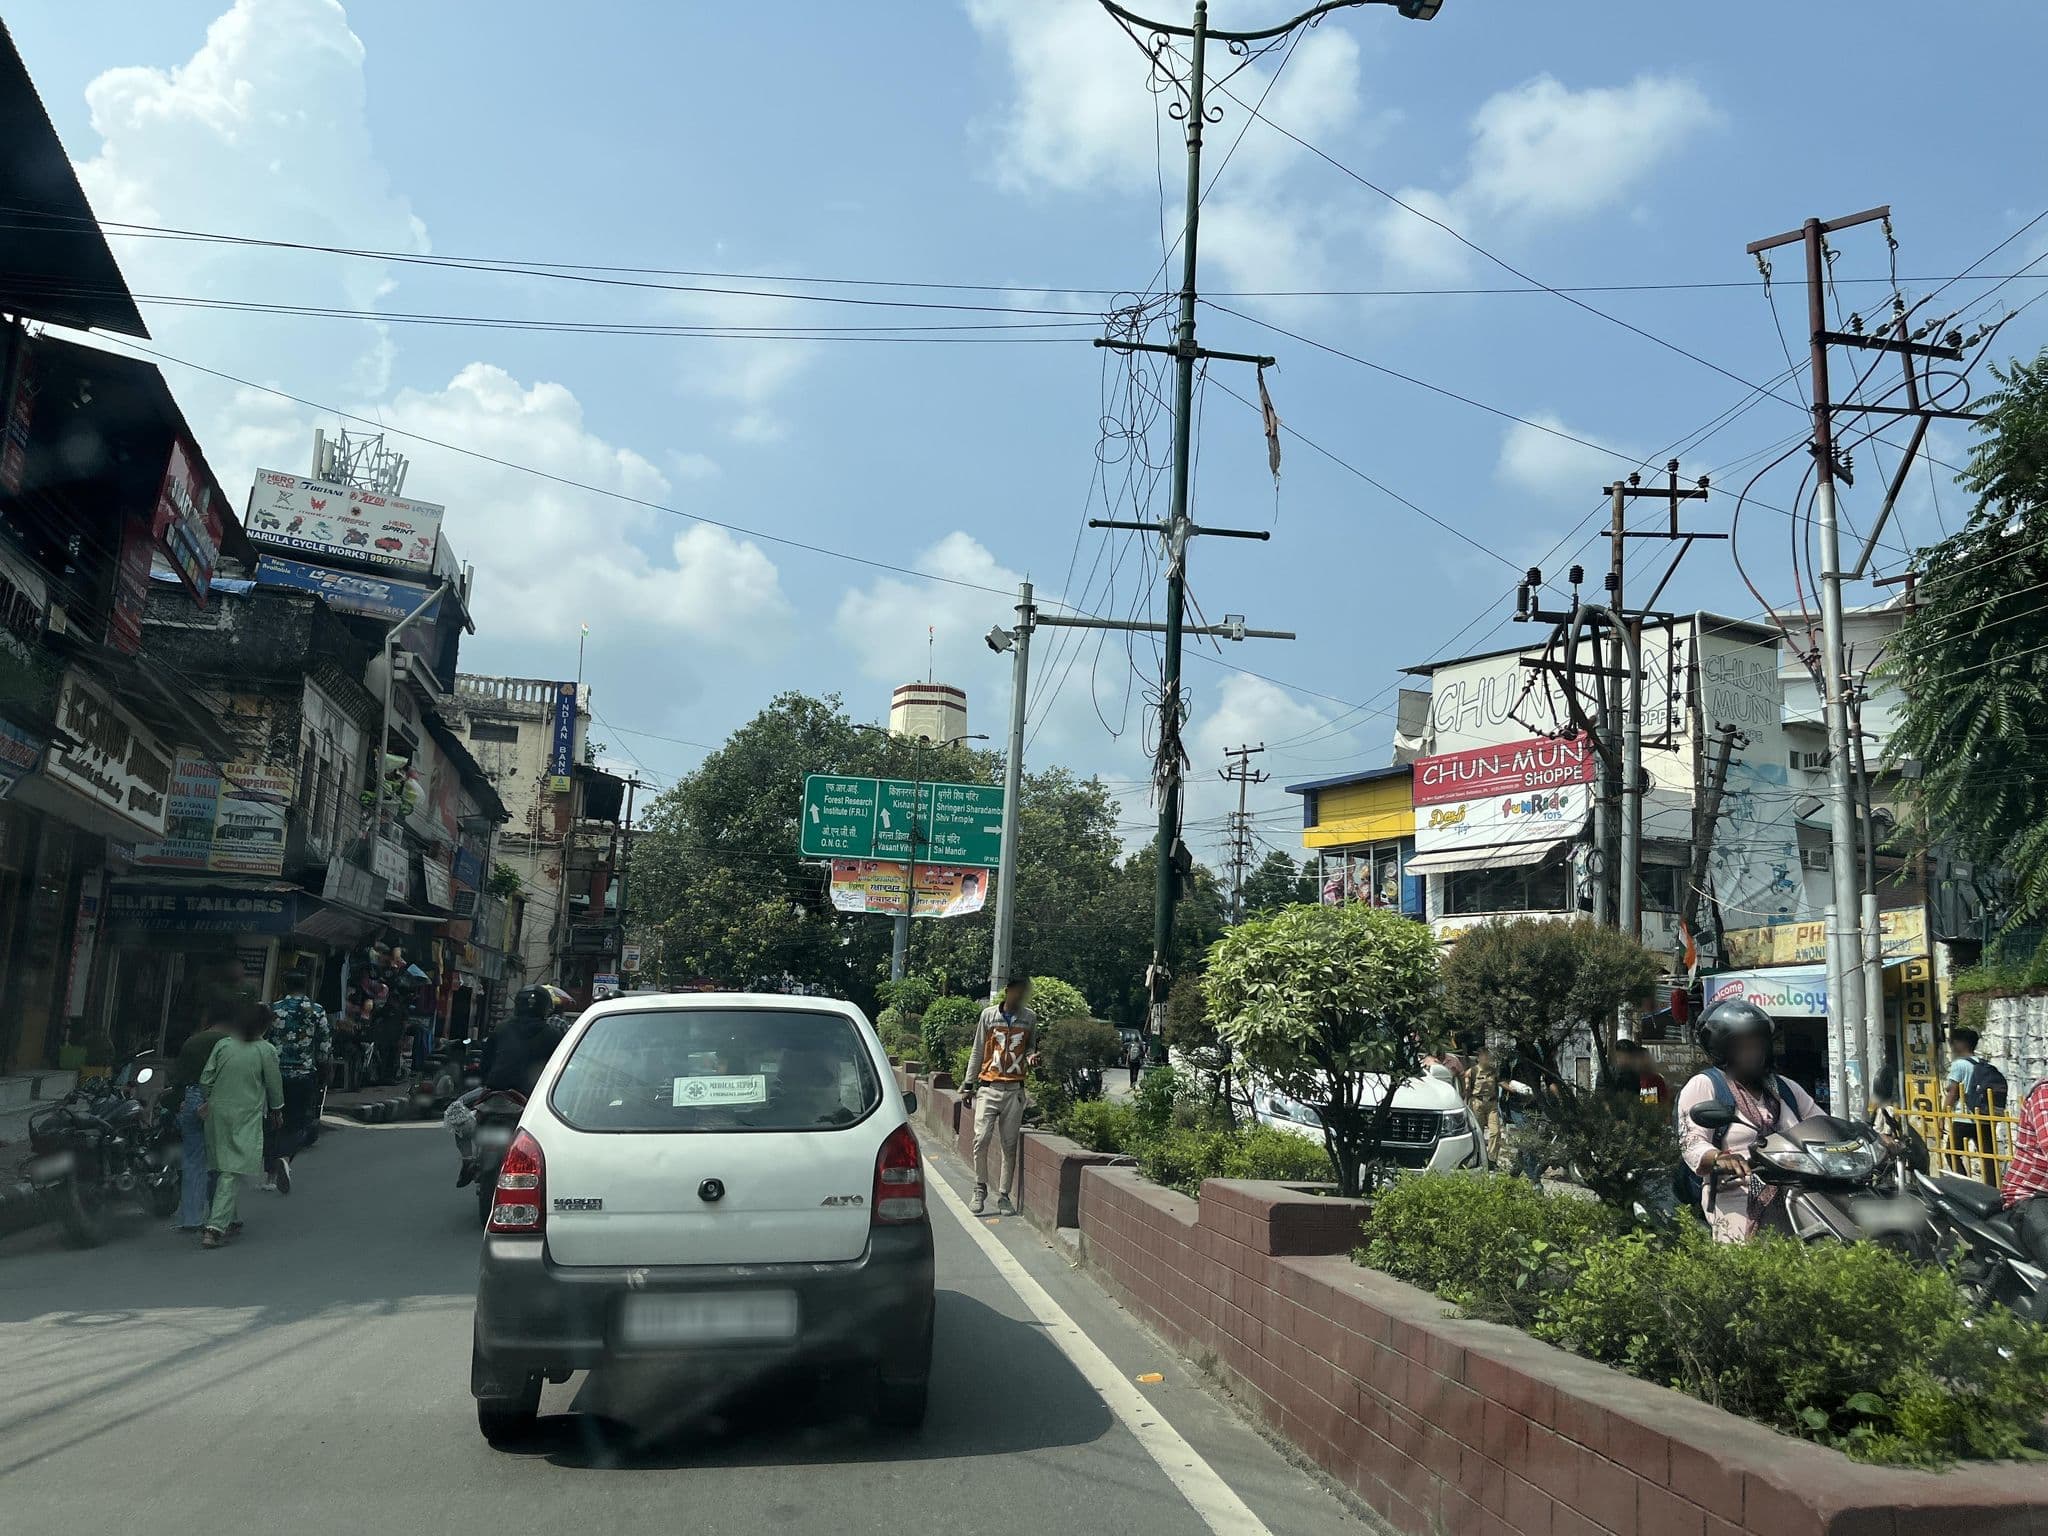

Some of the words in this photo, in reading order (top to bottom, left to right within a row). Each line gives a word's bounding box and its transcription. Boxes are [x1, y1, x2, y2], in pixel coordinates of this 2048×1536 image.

[267, 474, 295, 483] HERO
[246, 529, 289, 545] NARULA
[292, 538, 325, 552] CYCLE
[328, 546, 367, 561] WORKS
[1705, 654, 1777, 694] CHUN
[1713, 688, 1772, 724] MUN
[559, 697, 570, 739] INDIAN
[557, 746, 567, 775] BANK
[1423, 741, 1583, 785] CHUN-MUN
[1524, 765, 1583, 787] SHOPPE
[824, 795, 844, 804] Forest
[845, 796, 873, 806] Research
[937, 802, 965, 814] Shringeri
[823, 806, 848, 816] Institute
[936, 813, 950, 822] Shiv
[951, 814, 974, 825] Temple
[878, 842, 899, 852] Vasant
[933, 846, 944, 855] Sai
[945, 846, 967, 856] Mandir
[185, 896, 284, 913] TAILORS
[1747, 985, 1828, 1014] mixology
[820, 1195, 863, 1206] ALTO
